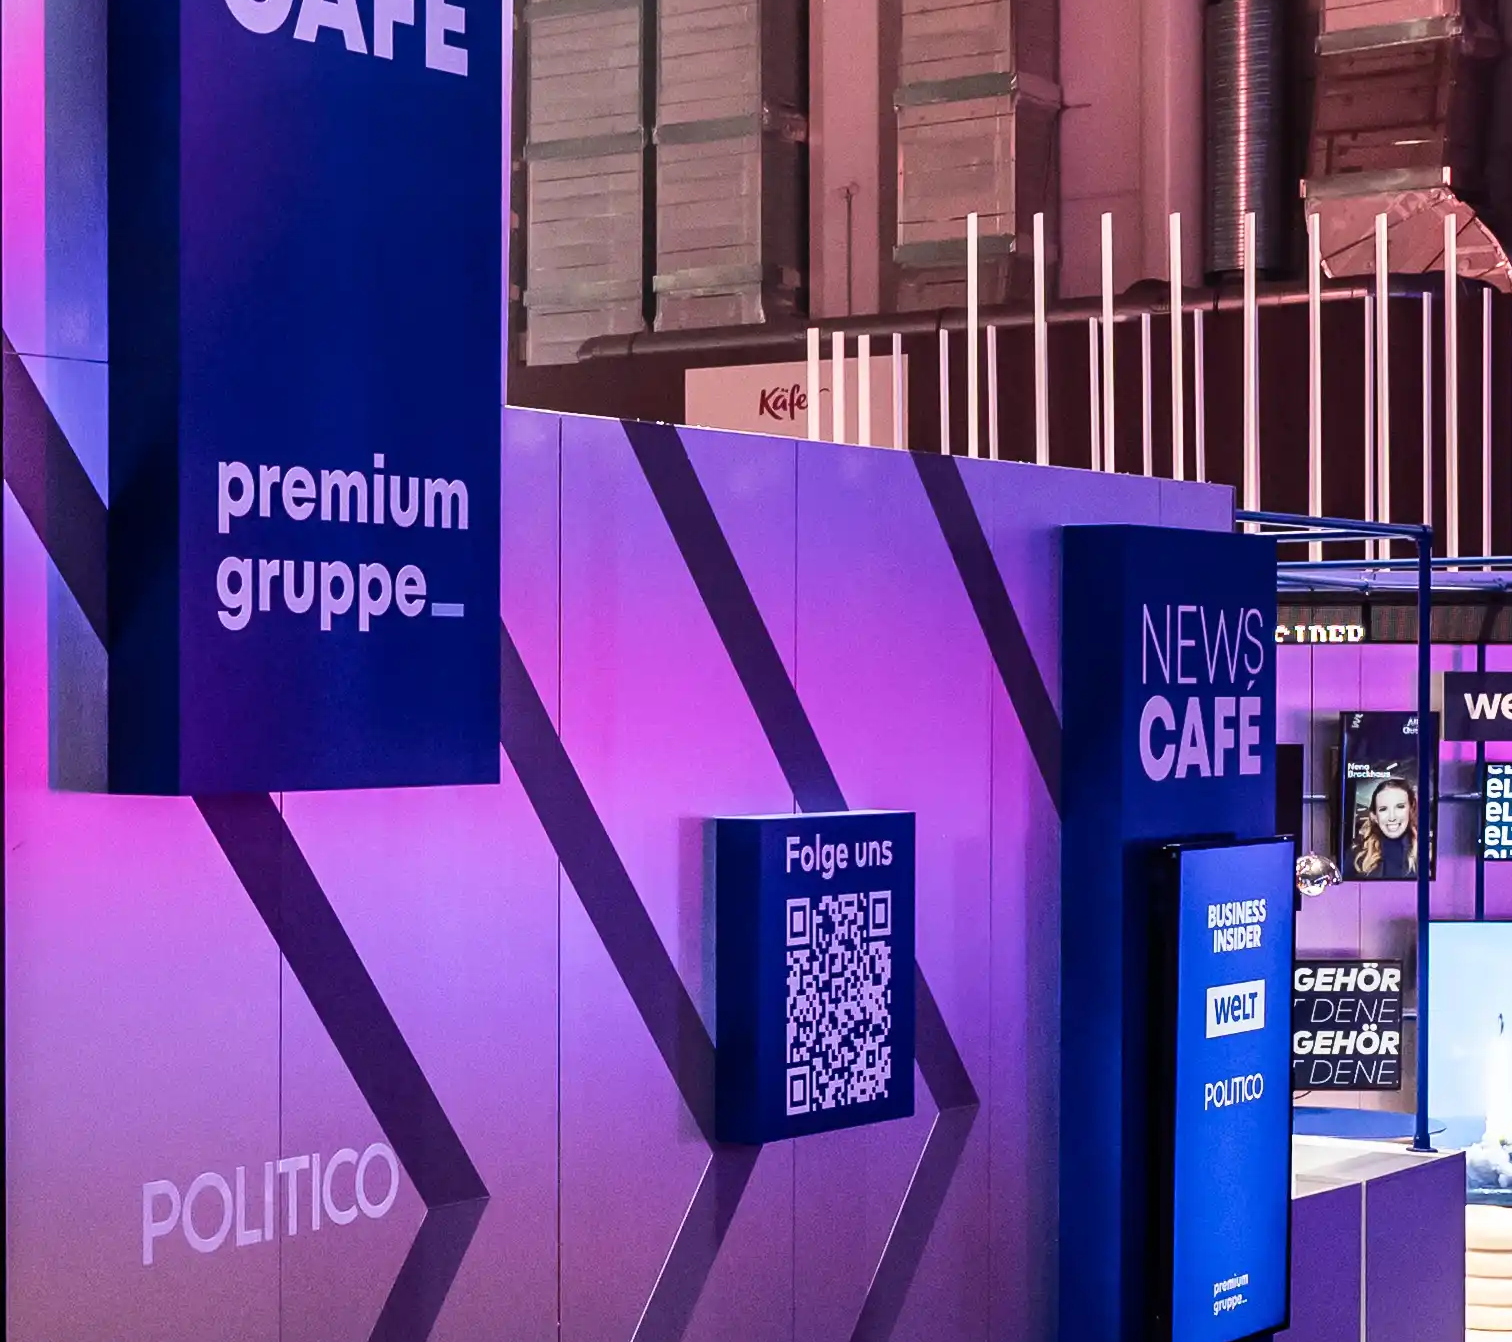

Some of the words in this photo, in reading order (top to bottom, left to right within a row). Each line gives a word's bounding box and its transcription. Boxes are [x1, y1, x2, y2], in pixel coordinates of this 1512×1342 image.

[218, 454, 471, 537] premium
[1142, 603, 1264, 685] NEWS
[1139, 679, 1262, 782] CAFÉ
[786, 833, 849, 880] Folge
[855, 840, 893, 868] uns
[1207, 898, 1267, 929] BUSINESS
[1213, 924, 1262, 954] INSIDER
[1310, 998, 1400, 1023] DENE
[1204, 1072, 1264, 1111] POLITICO
[1309, 1060, 1399, 1084] DENE
[141, 1140, 400, 1266] POLITICO
